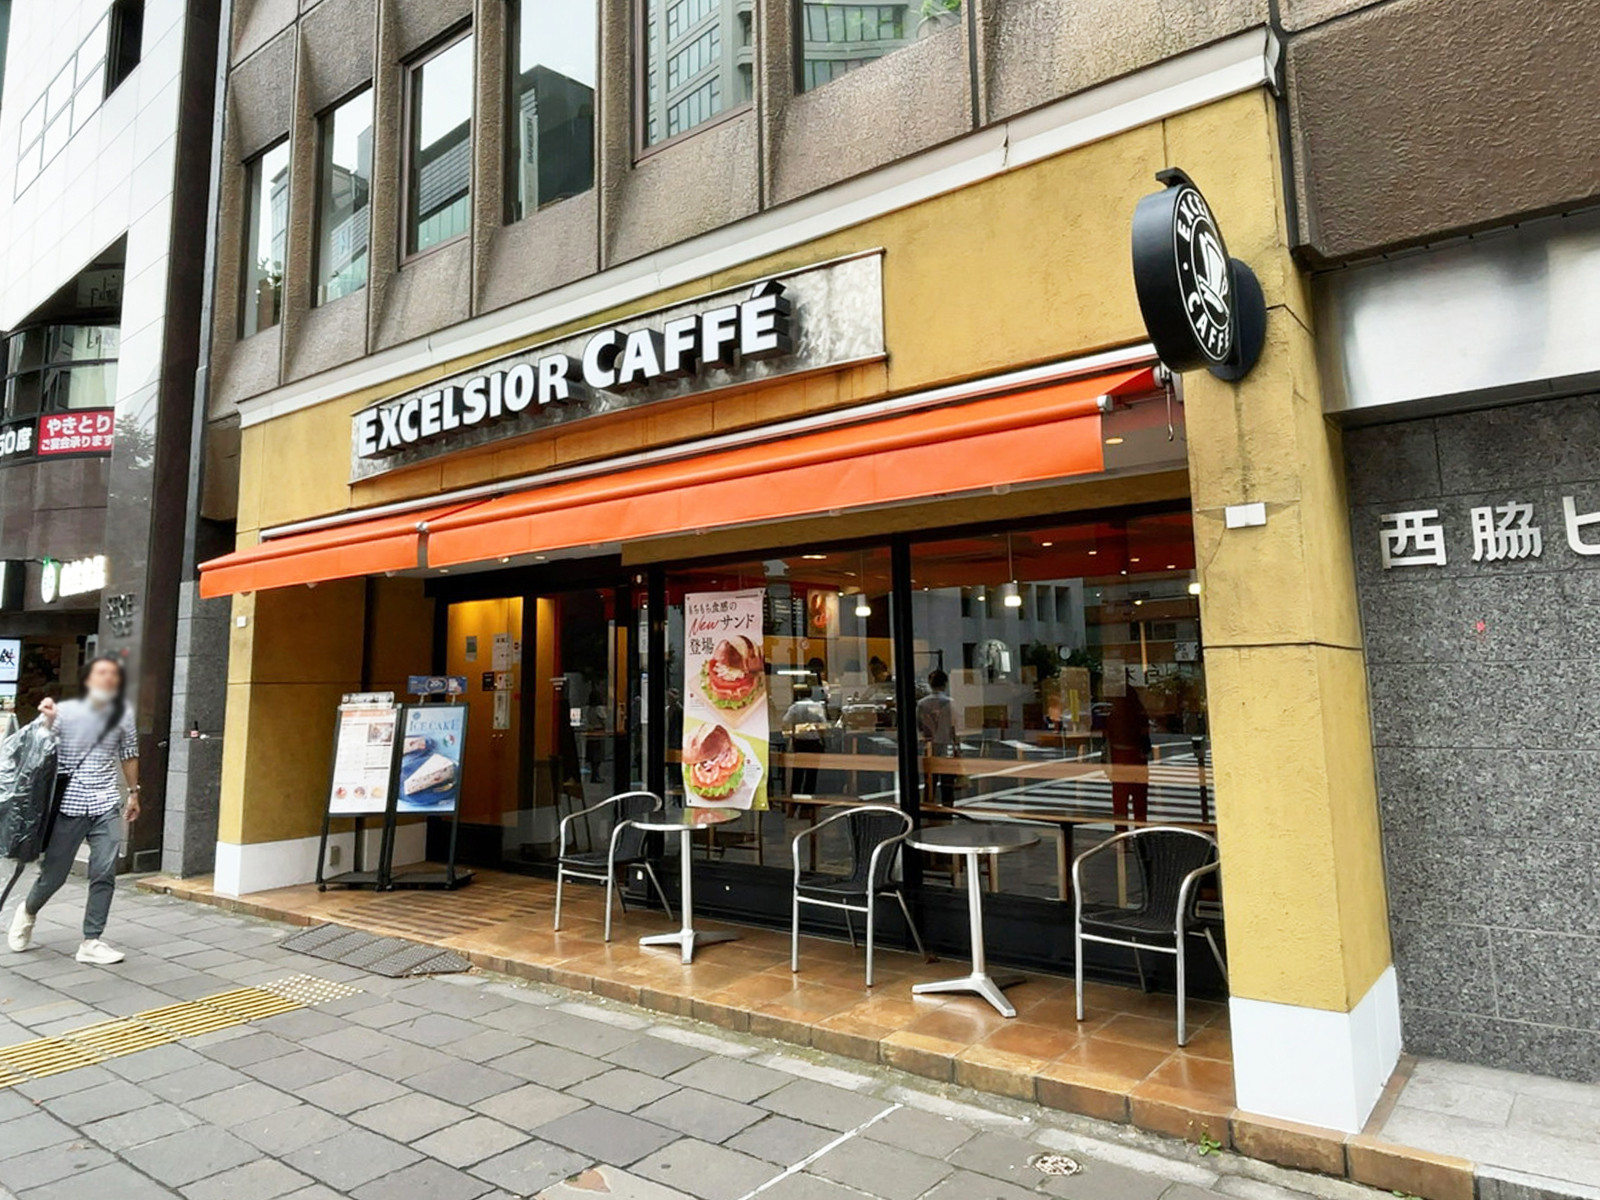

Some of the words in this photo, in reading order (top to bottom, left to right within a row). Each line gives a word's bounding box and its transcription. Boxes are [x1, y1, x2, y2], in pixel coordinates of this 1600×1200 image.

[358, 353, 570, 459] EXCELSIOR
[582, 281, 779, 389] CAFFÉ
[47, 414, 111, 436] やきとり
[688, 600, 737, 615] もちもち食感の
[690, 637, 715, 655] 登場
